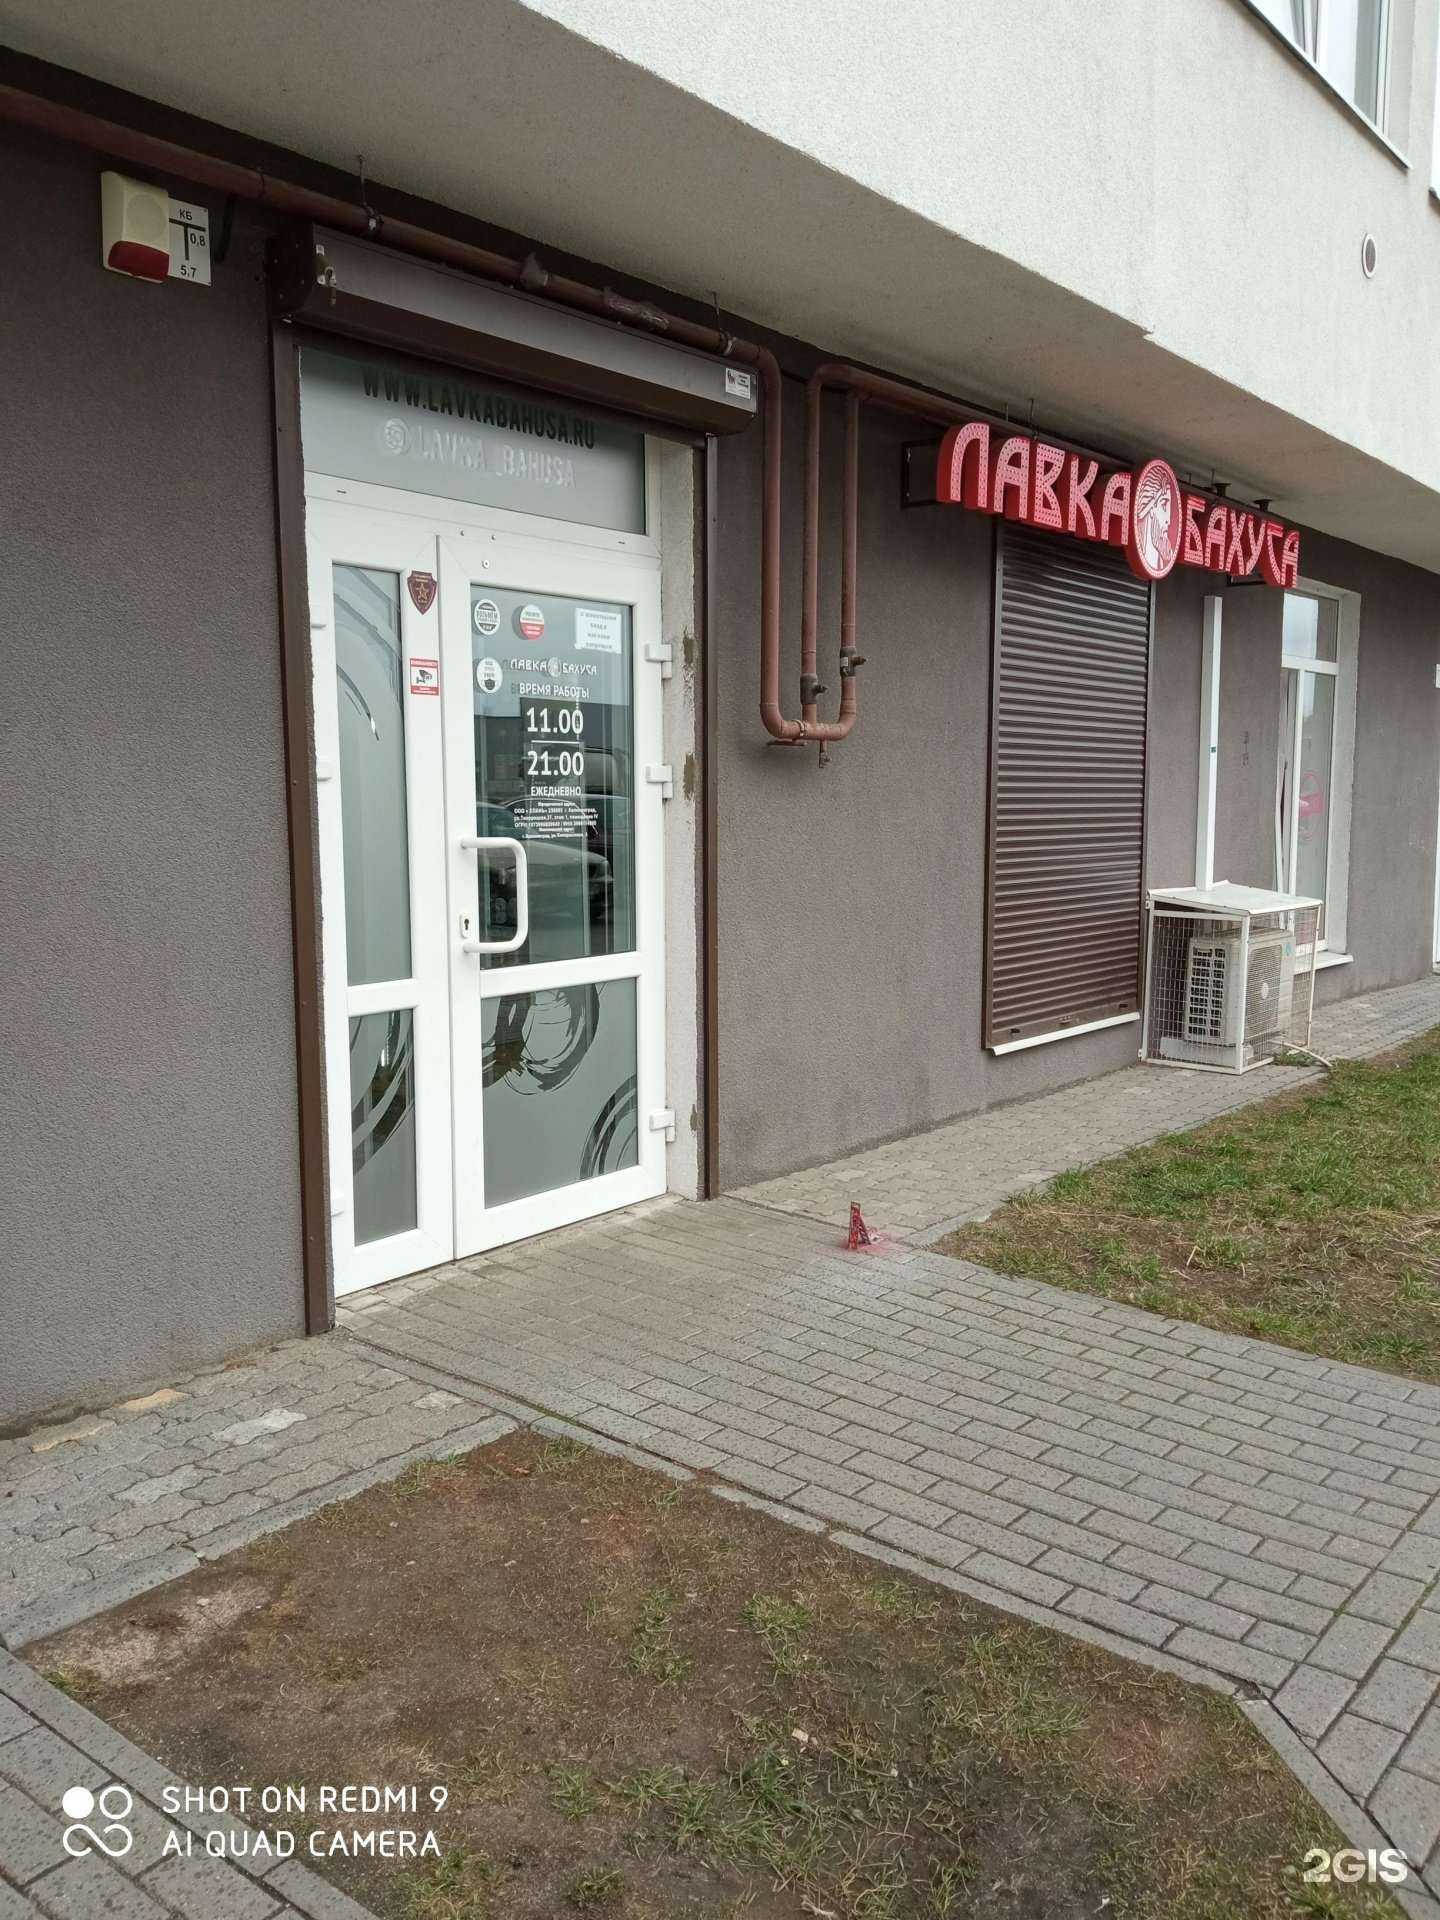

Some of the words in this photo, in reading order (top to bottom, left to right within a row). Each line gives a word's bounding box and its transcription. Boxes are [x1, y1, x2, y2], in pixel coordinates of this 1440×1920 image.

[179, 209, 193, 221] КБ
[361, 365, 596, 450] WWW.LAVKABAHUSA.RU
[943, 421, 1132, 547] ЛАВКА
[1182, 495, 1300, 589] БАХУСА
[510, 658, 547, 671] ЛАВКА
[562, 662, 597, 675] БАХУСА
[519, 682, 551, 695] ВРЕМЯ
[553, 684, 590, 698] РАБОТЫ
[526, 706, 584, 734] 11.00
[527, 750, 584, 776] 21.00
[530, 785, 582, 798] ЕЖЕДНЕВНО
